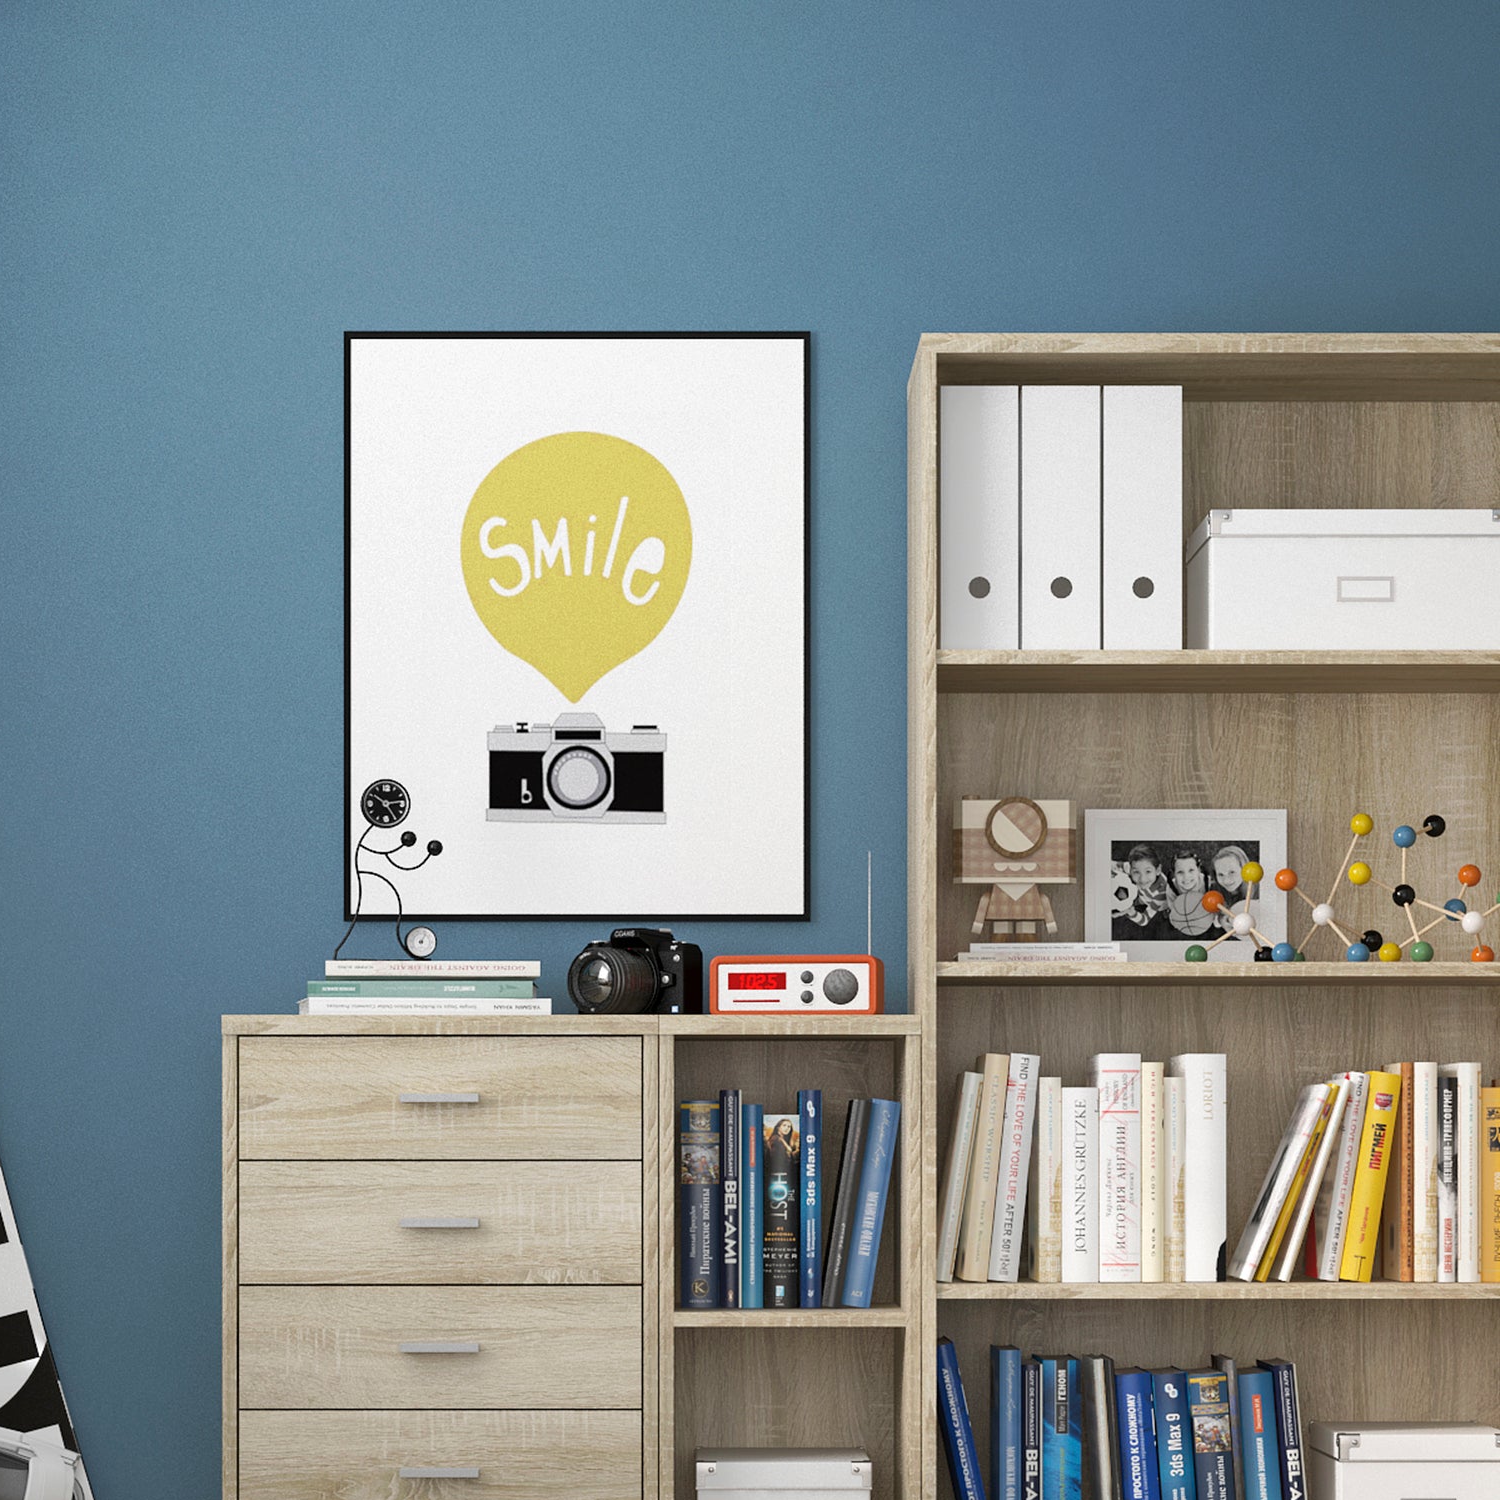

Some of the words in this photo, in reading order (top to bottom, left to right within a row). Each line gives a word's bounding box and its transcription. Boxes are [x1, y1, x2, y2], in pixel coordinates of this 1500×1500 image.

[1019, 1057, 1030, 1080] FIND
[1016, 1083, 1027, 1102] THE
[1203, 1071, 1213, 1120] LORIOT
[1355, 1075, 1365, 1096] FIND
[727, 1114, 734, 1126] DE
[1013, 1104, 1025, 1131] LOVE
[1352, 1100, 1362, 1115] THE
[807, 1134, 816, 1143] 9
[1012, 1134, 1022, 1147] OF
[1074, 1099, 1087, 1171] GRÜTZKE
[1348, 1119, 1359, 1143] LOVE
[1115, 1126, 1126, 1180] АНГЛИИ
[1346, 1145, 1354, 1158] OF
[1368, 1122, 1387, 1171] ПИГМЕЙ
[807, 1147, 816, 1177] Max
[1008, 1149, 1020, 1178] YOUR
[1341, 1160, 1352, 1186] YOUR
[700, 1188, 713, 1220] войны
[770, 1172, 788, 1220] HOST
[807, 1181, 816, 1206] 3ds
[1006, 1180, 1017, 1201] LIFE
[1338, 1188, 1348, 1207] LIFE
[725, 1180, 737, 1264] BEL-AMI
[1002, 1203, 1015, 1236] AFTER
[1074, 1174, 1087, 1255] JOHANNES
[1115, 1186, 1126, 1250] ИСТОРИЯ
[1334, 1209, 1344, 1239] AFTER
[700, 1222, 713, 1275] Пиратские
[1443, 1254, 1453, 1274] ЕЛЕНА
[942, 1368, 959, 1428] СЛОЖНОМУ
[1028, 1387, 1035, 1397] DE
[1056, 1369, 1066, 1401] ГЕНОМ
[1284, 1388, 1291, 1397] DE
[1126, 1393, 1138, 1446] СЛОЖНОМУ
[1166, 1413, 1180, 1421] 9
[1285, 1398, 1295, 1446] MAUPASSANT
[955, 1430, 961, 1438] К
[1167, 1424, 1183, 1451] Max
[957, 1439, 972, 1489] ПРОСТОГО
[1170, 1454, 1185, 1477] 3ds
[1256, 1437, 1265, 1472] ЭКОНОМИКИ
[1131, 1456, 1143, 1498] ПРОСТОГО
[1216, 1456, 1226, 1485] войны
